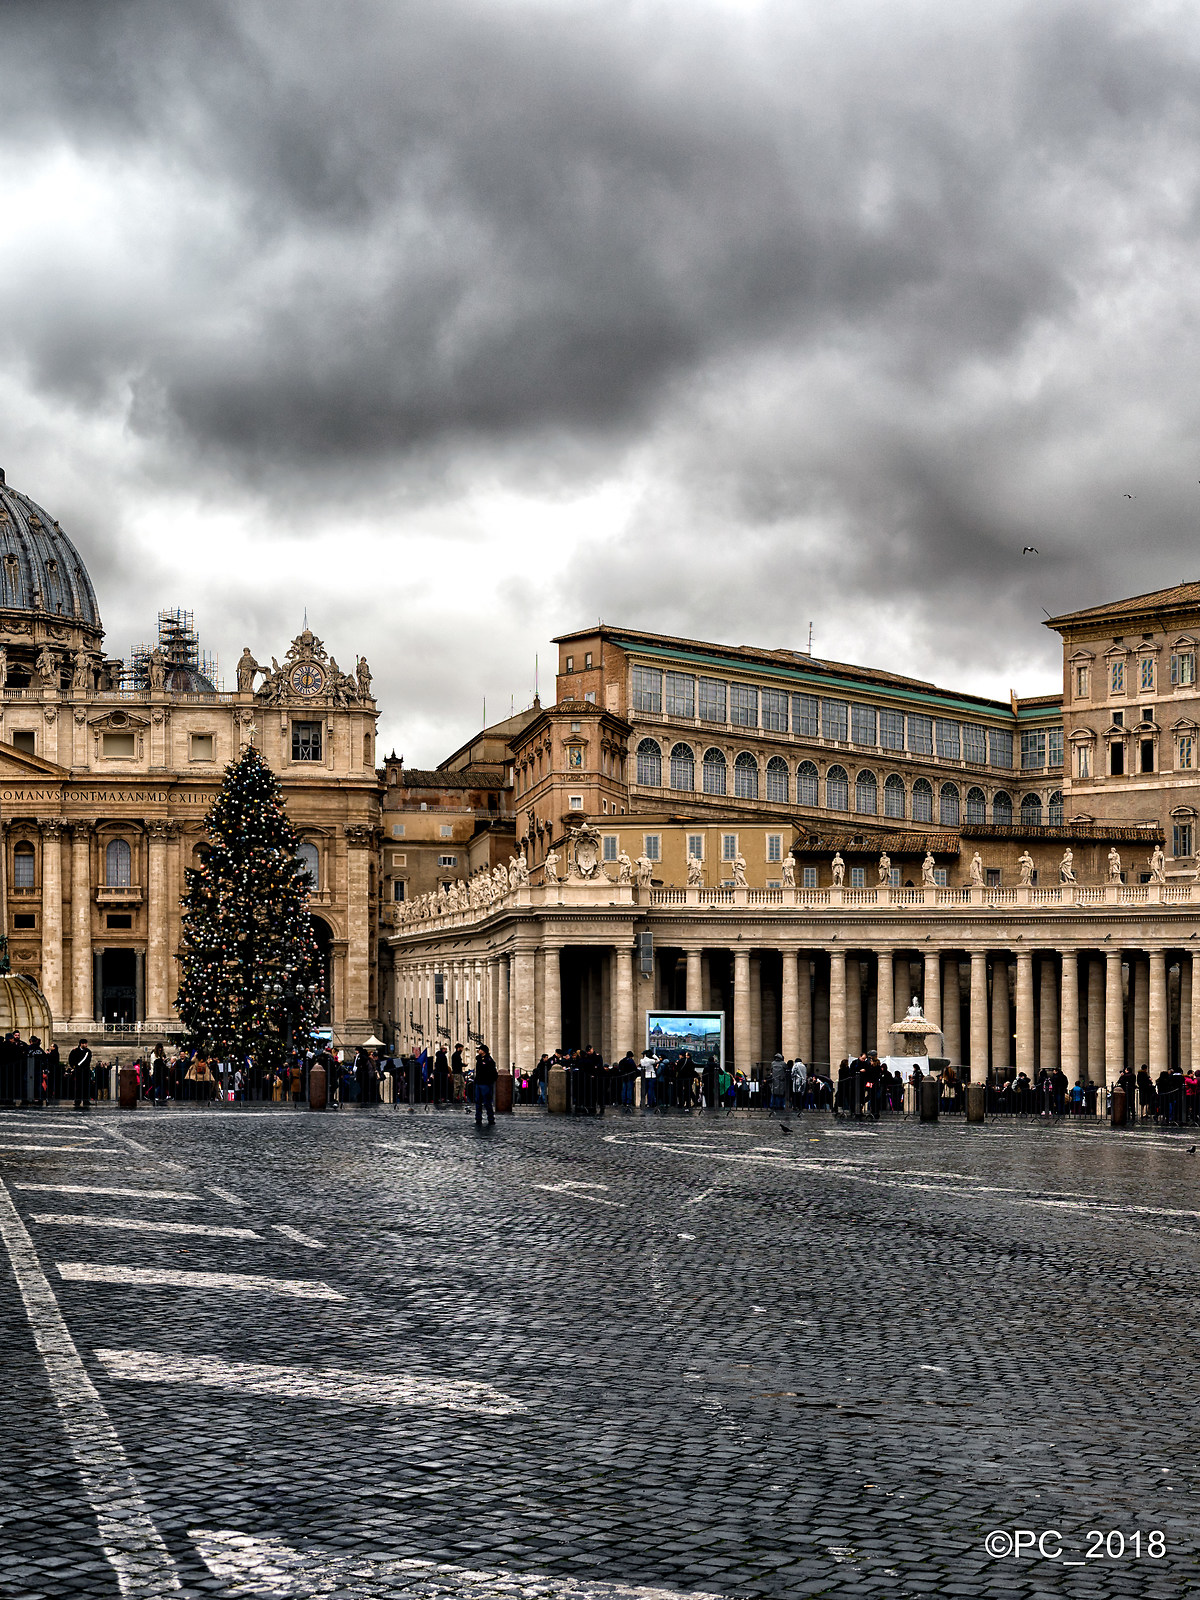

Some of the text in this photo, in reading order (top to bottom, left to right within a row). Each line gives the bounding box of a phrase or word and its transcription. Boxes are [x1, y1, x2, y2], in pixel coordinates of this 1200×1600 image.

[0, 790, 60, 800] OMANVS
[63, 791, 96, 801] PONT
[97, 791, 126, 801] MAX
[127, 792, 144, 801] AN
[148, 792, 198, 803] MDCXII
